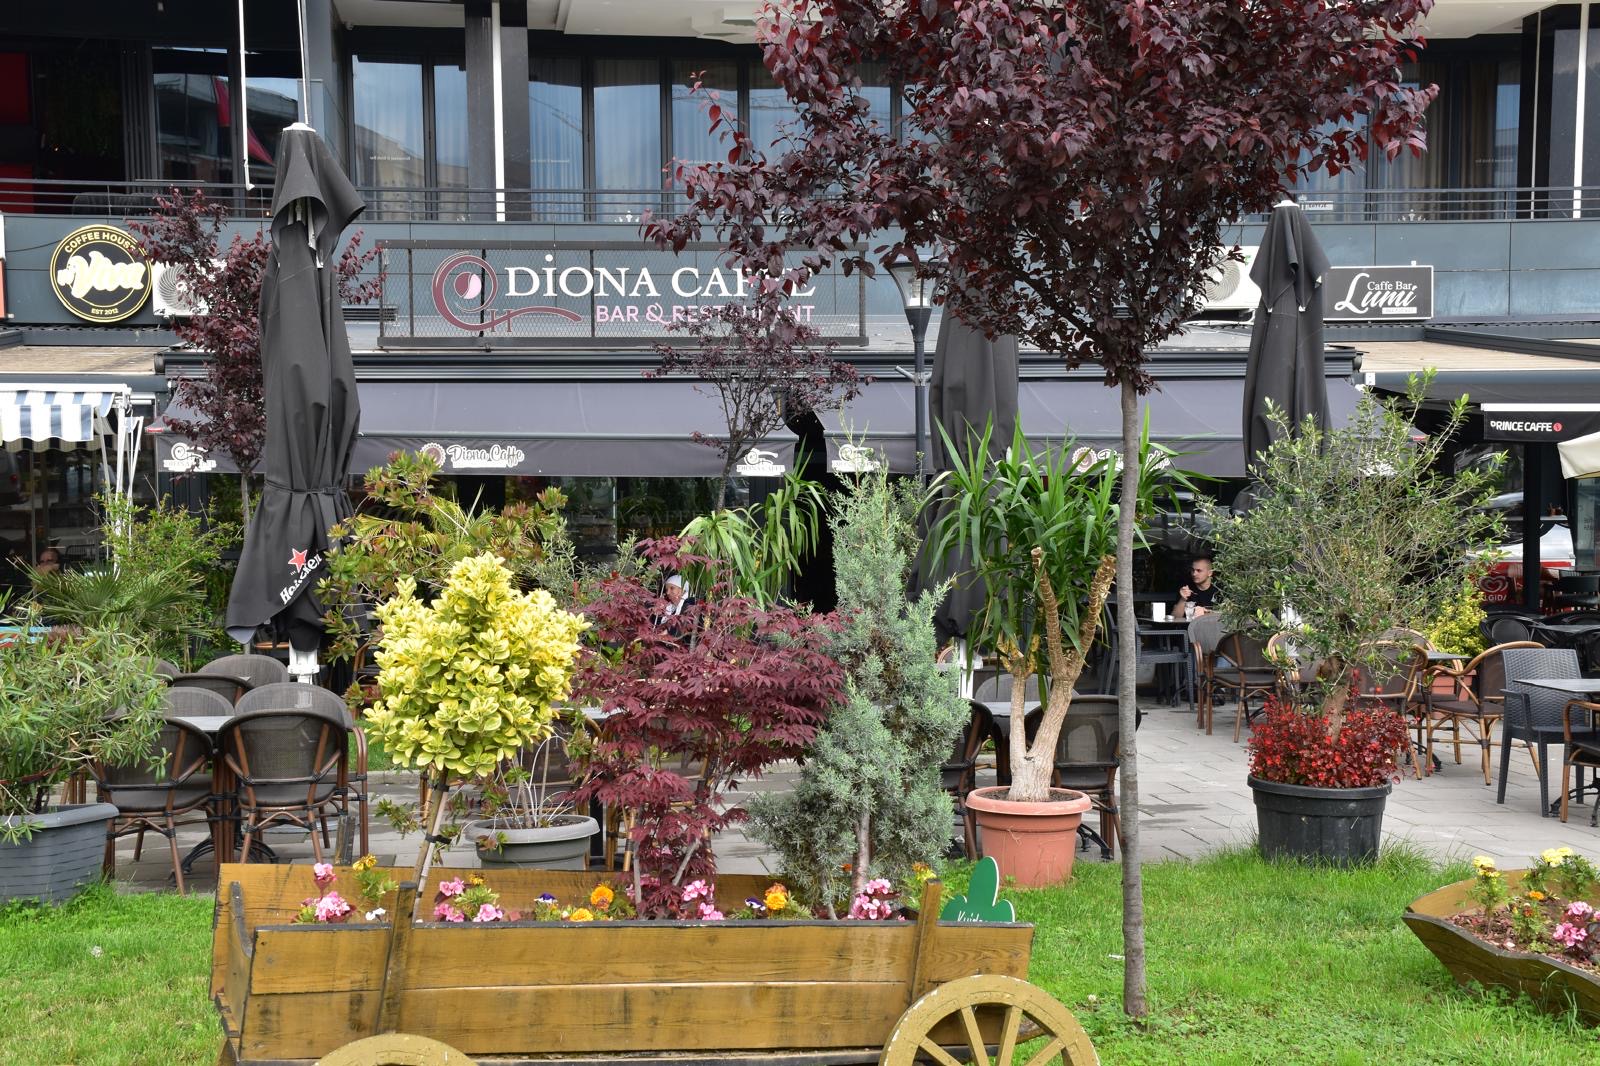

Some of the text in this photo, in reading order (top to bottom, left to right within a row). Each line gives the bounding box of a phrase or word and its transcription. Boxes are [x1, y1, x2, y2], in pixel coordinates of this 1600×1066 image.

[64, 231, 100, 254] COFFEE
[1334, 272, 1418, 315] Lumi
[1366, 280, 1413, 291] Caffe Bar
[596, 305, 639, 322] BAR
[645, 302, 672, 325] &
[1524, 421, 1553, 432] CAFFE
[446, 444, 525, 467] Diona Caffe
